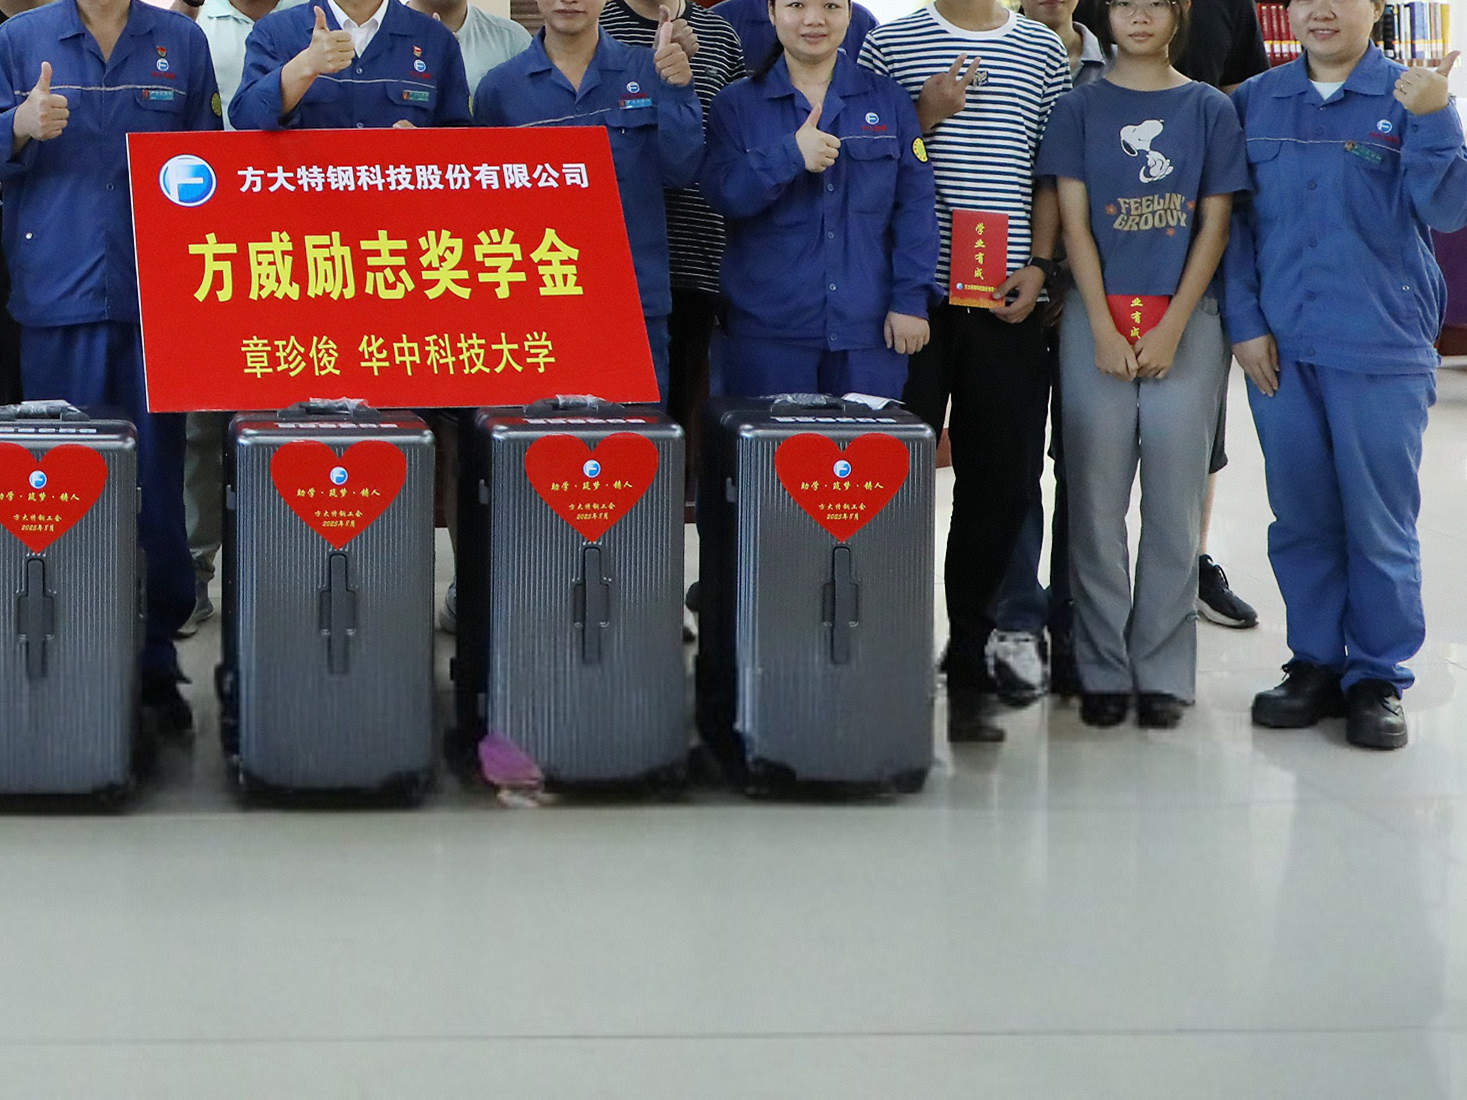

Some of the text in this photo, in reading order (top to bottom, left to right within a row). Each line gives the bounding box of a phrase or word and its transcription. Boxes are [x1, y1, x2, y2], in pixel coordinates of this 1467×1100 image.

[237, 162, 590, 194] 方大特钢科技股份有限公司
[1113, 209, 1187, 231] GROOVY
[187, 227, 584, 303] 方威励志奖学金
[240, 330, 556, 379] 章珍俊 华中科技大学
